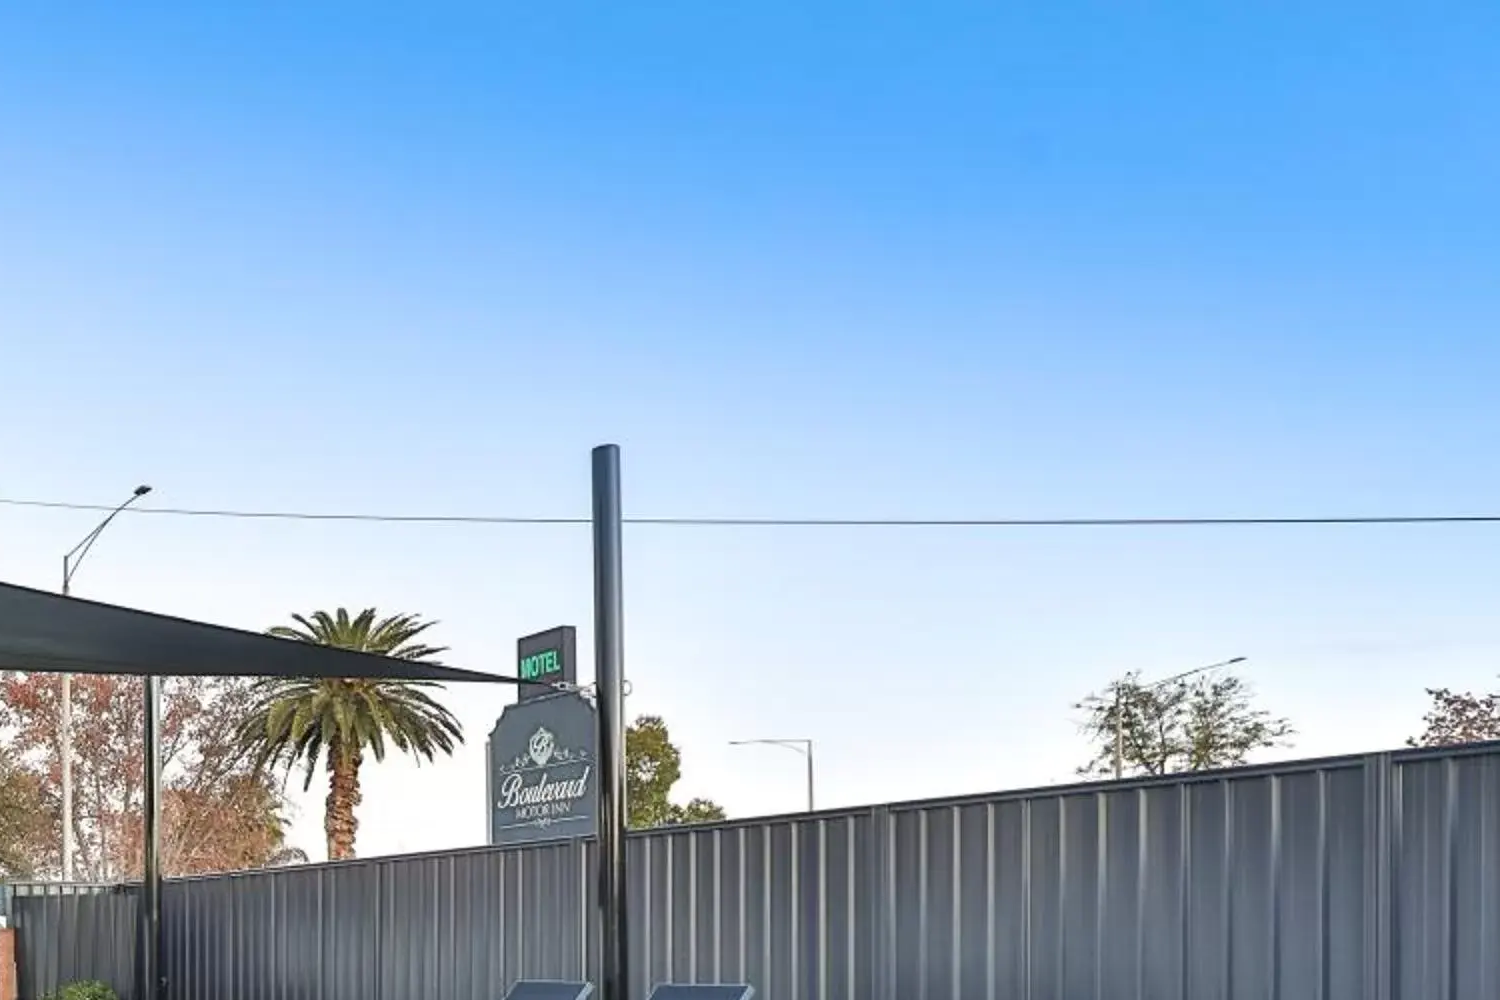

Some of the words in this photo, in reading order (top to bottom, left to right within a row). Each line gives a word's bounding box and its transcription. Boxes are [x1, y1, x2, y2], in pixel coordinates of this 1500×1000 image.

[521, 650, 560, 680] MOTEL
[498, 765, 588, 809] Boulevard
[516, 803, 550, 819] MOTOR
[551, 800, 571, 816] INN
